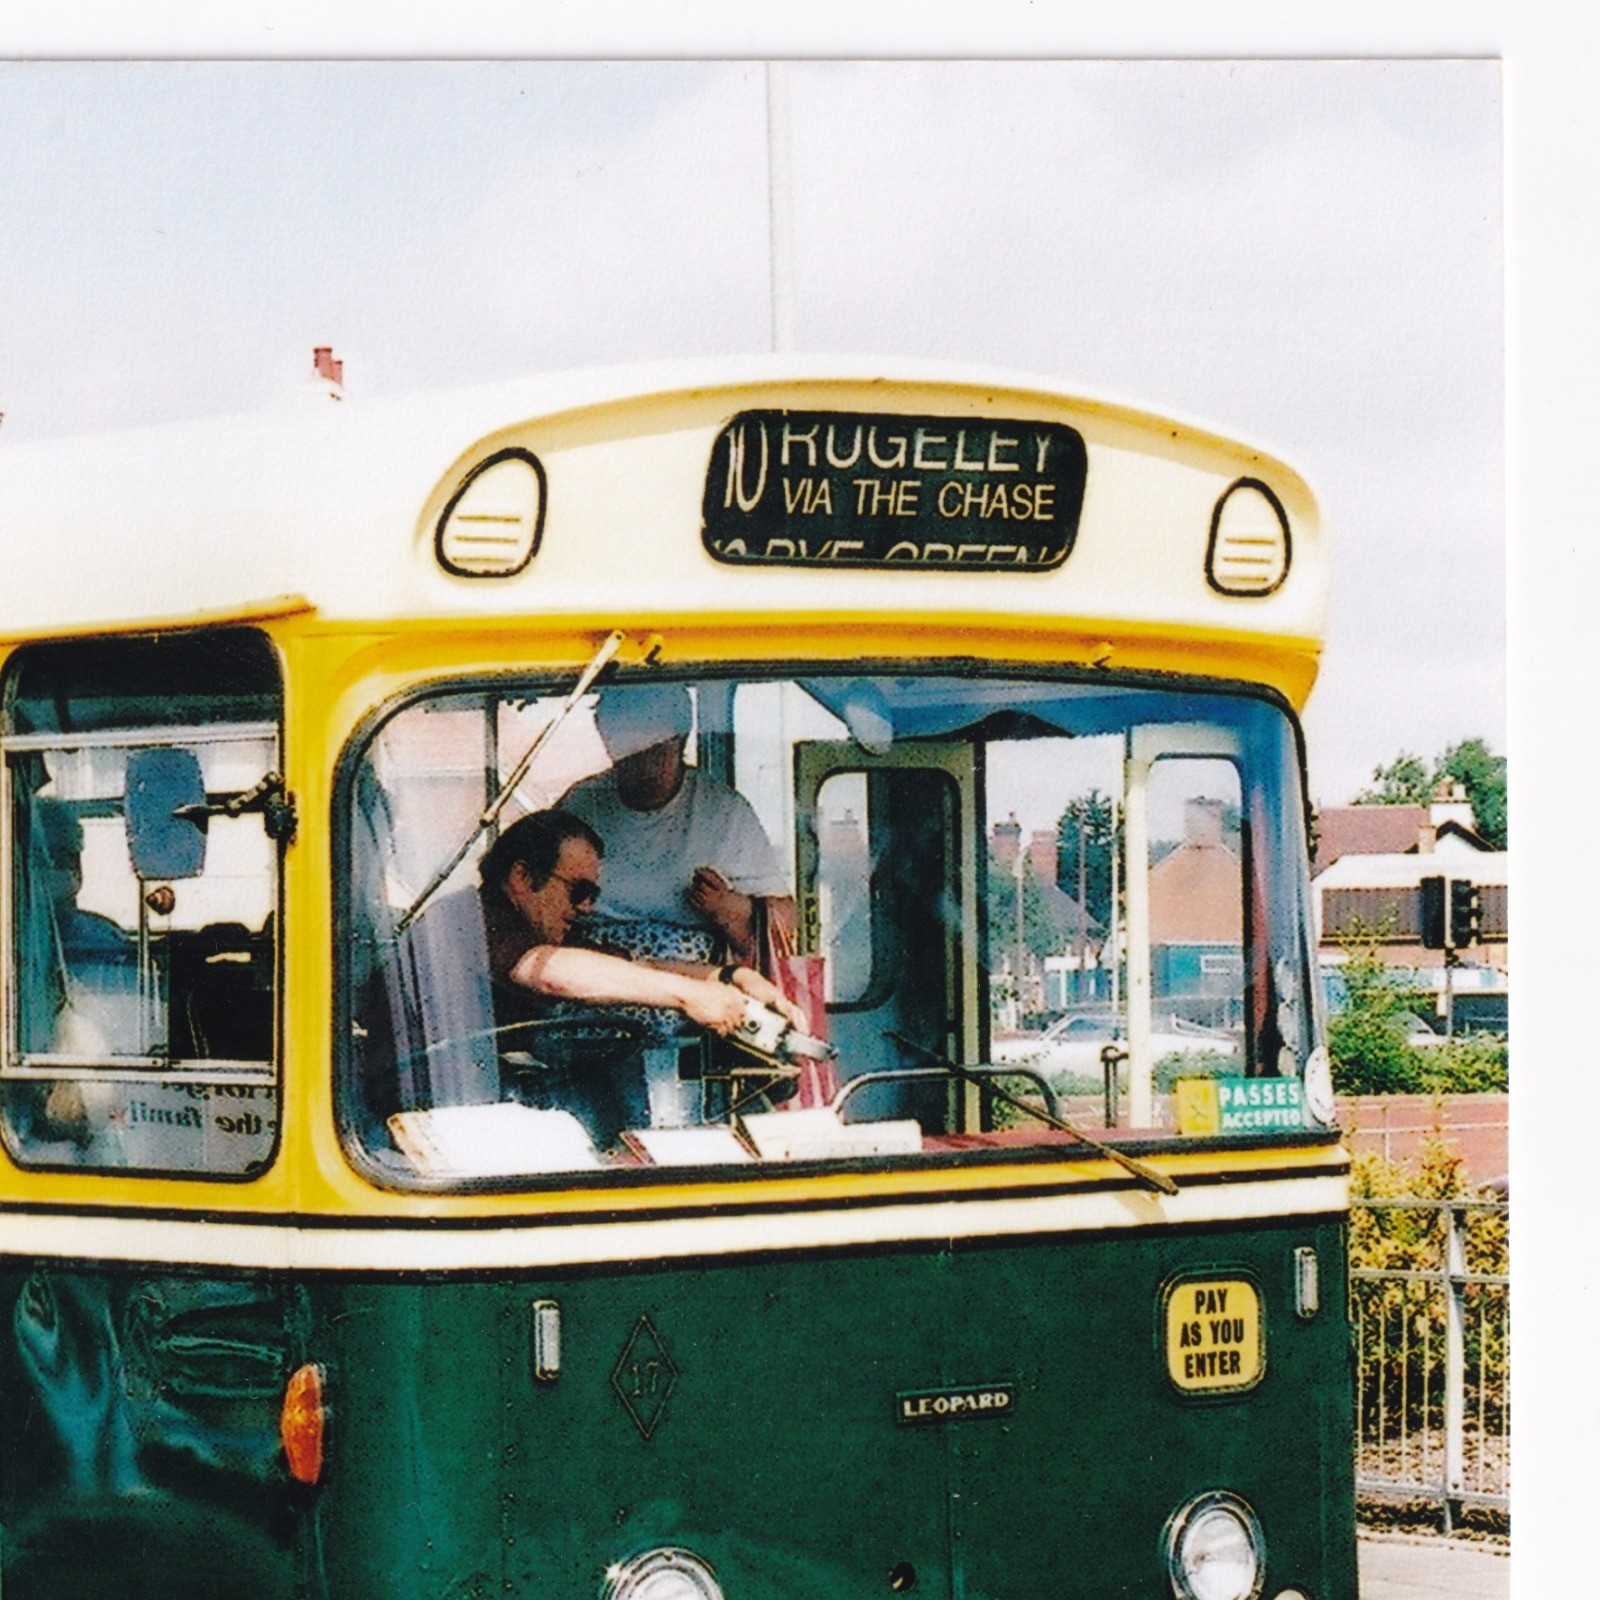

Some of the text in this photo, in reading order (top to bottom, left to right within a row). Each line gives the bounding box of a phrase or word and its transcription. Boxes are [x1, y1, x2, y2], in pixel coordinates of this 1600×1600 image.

[724, 420, 768, 512] 10
[783, 477, 1055, 520] VIA THE CHASE
[805, 897, 816, 953] PULL
[1219, 1083, 1300, 1107] PASSES
[1221, 1108, 1301, 1128] ACCEPTED
[1195, 1288, 1228, 1315] PAY
[1180, 1319, 1244, 1348] AS YOU
[1184, 1350, 1241, 1379] ENTER
[903, 1392, 1010, 1417] LEOPARD
